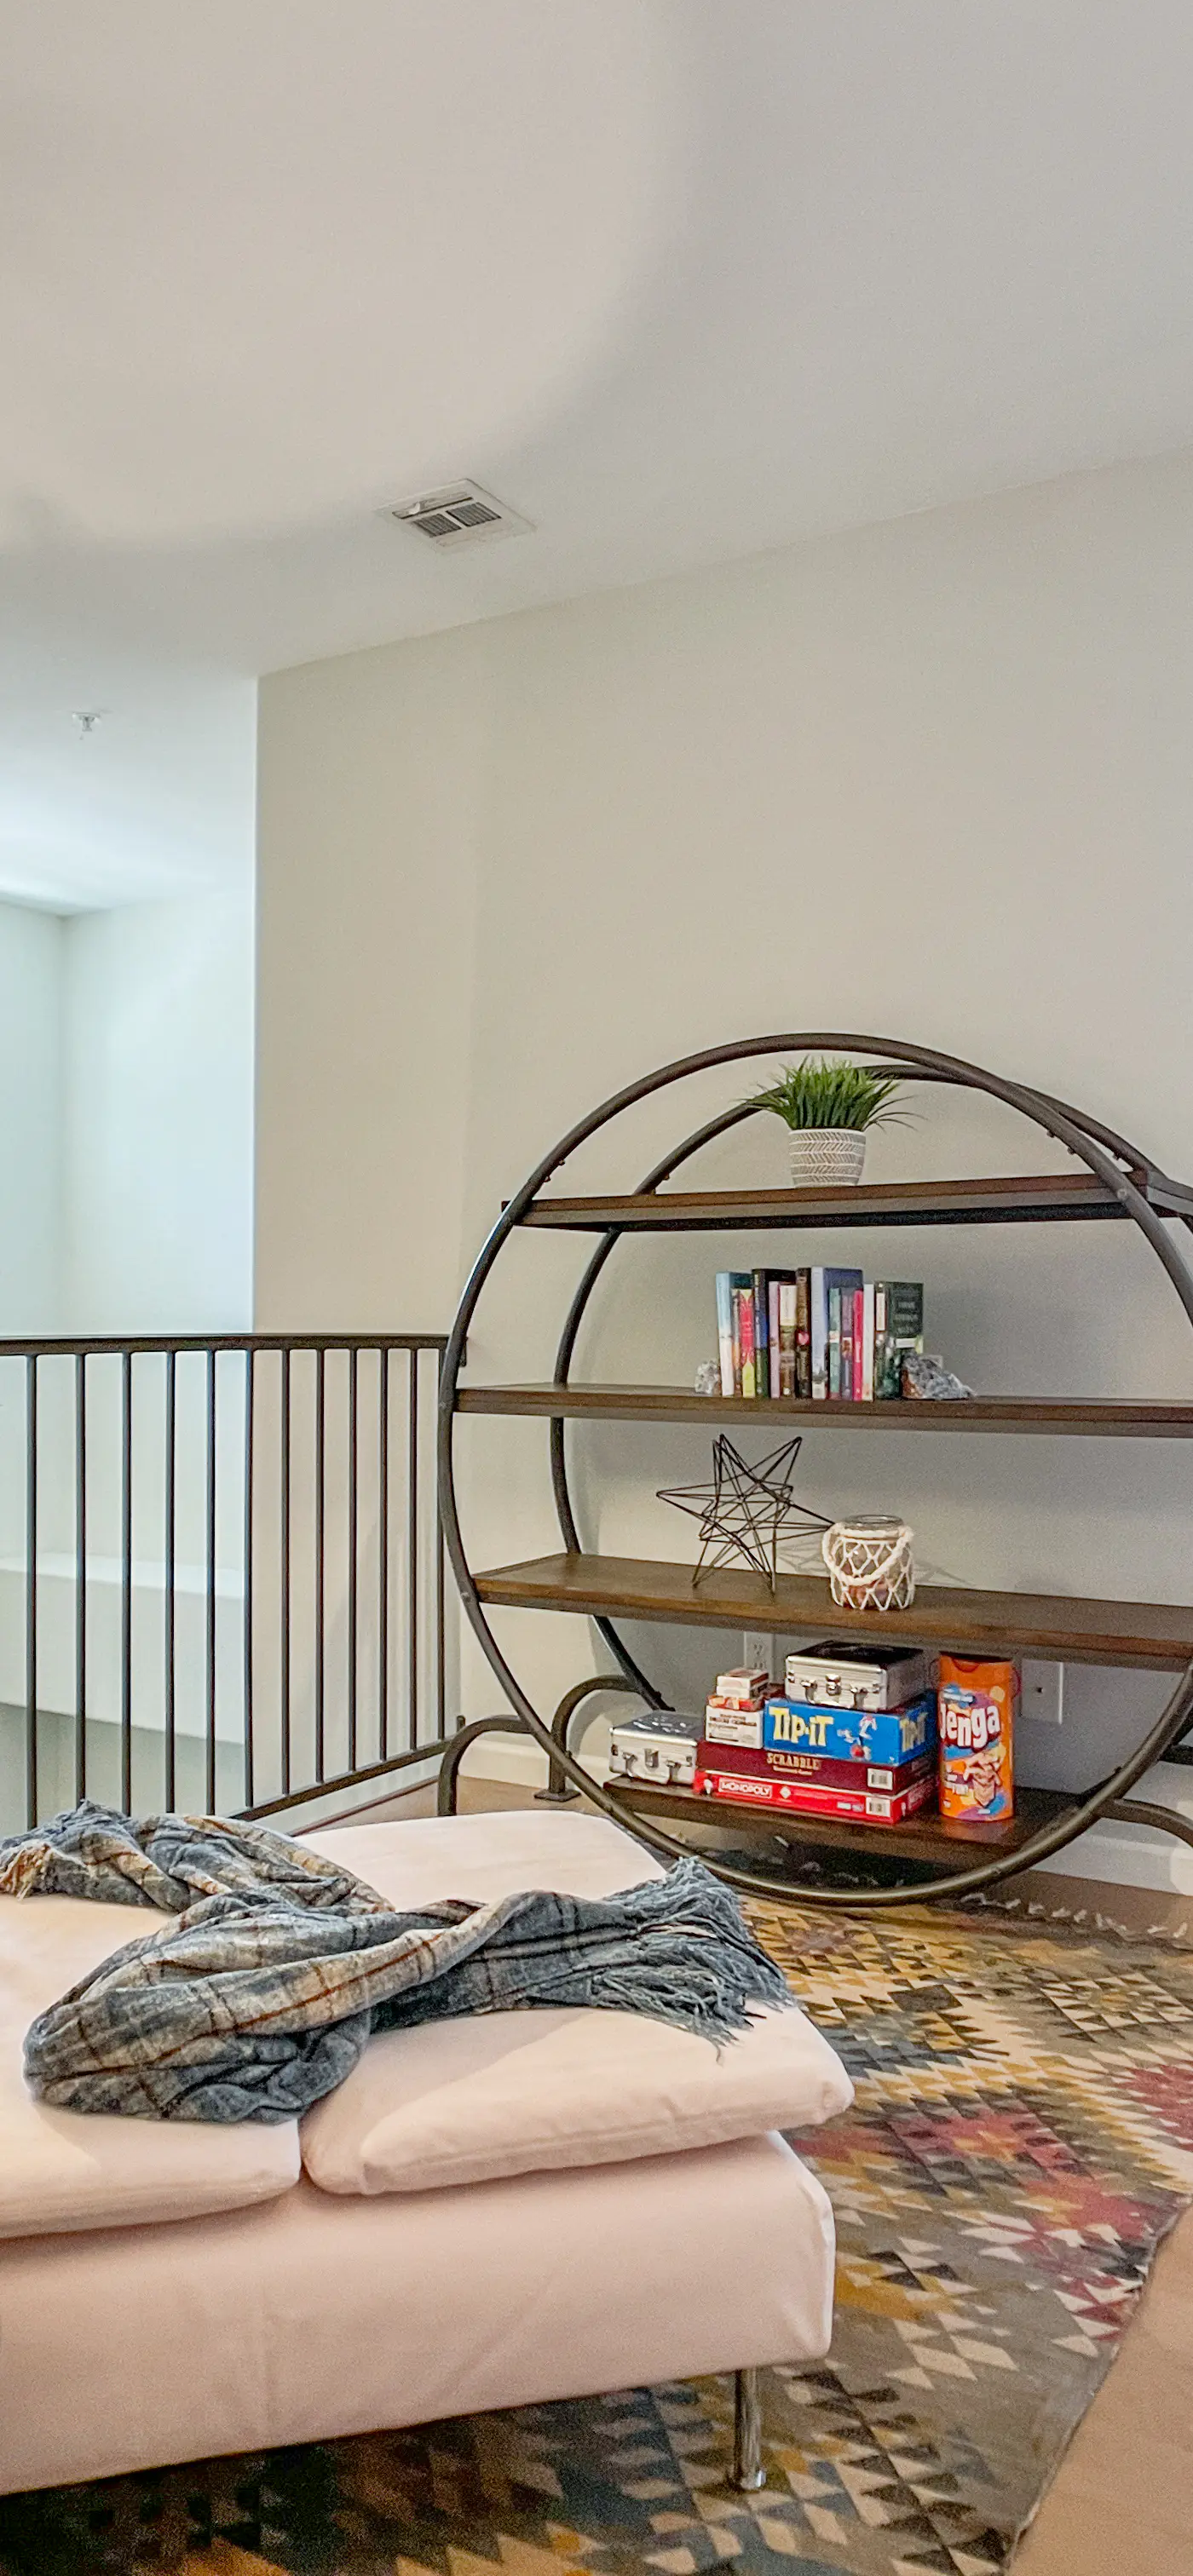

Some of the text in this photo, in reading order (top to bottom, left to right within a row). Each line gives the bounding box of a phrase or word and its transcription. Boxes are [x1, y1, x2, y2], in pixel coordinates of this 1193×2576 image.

[940, 1703, 1000, 1749] Jenga
[767, 1752, 821, 1770] SCRABBLE
[721, 1781, 769, 1796] MONOPOLY
